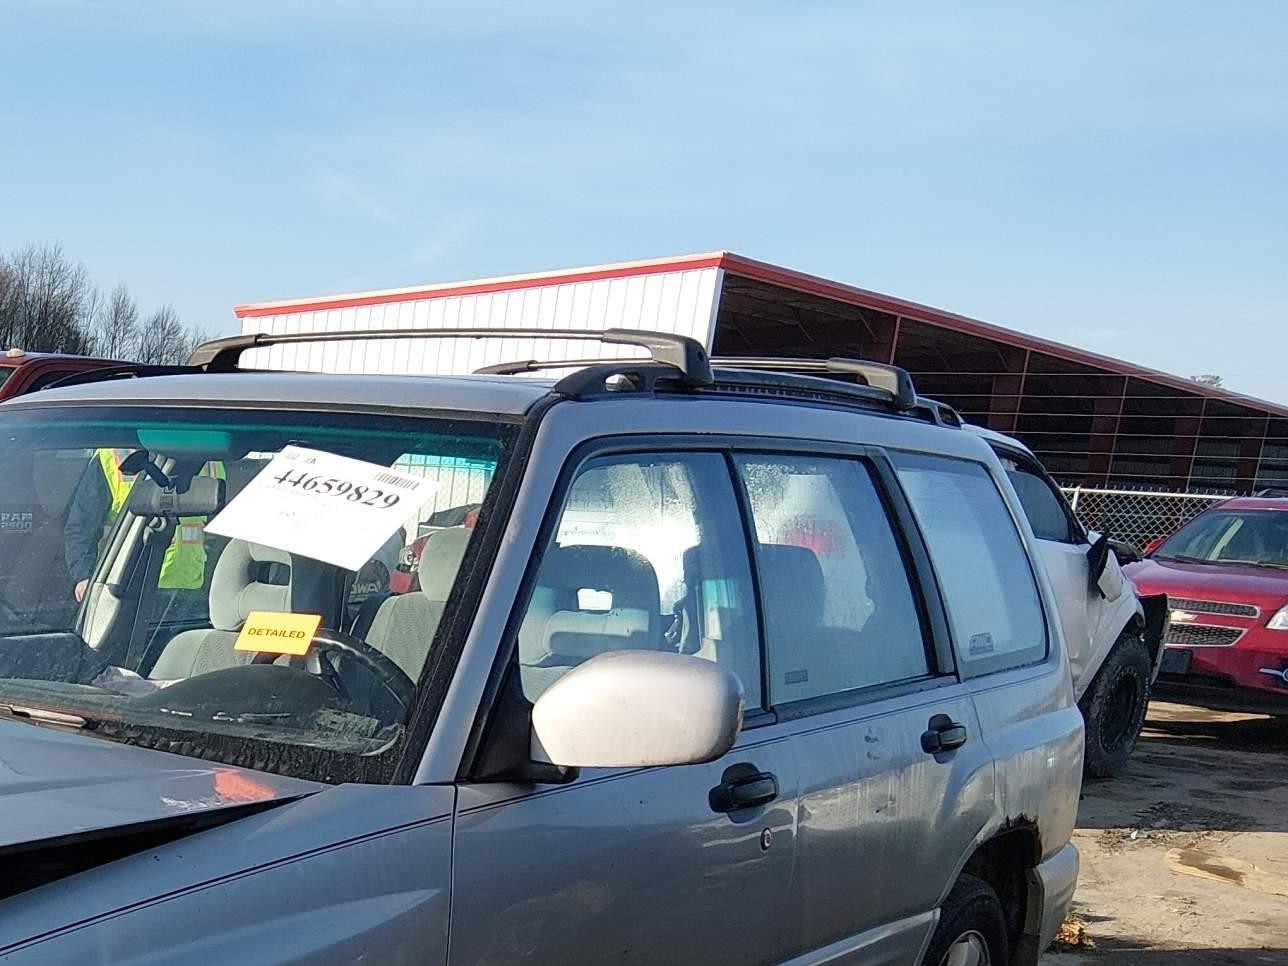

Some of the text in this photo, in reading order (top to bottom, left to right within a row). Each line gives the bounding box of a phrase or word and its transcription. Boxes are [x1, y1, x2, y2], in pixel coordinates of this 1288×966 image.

[274, 468, 400, 508] 44659829
[0, 512, 33, 521] RAM
[0, 521, 33, 530] 2500
[247, 627, 306, 639] DETAILED
